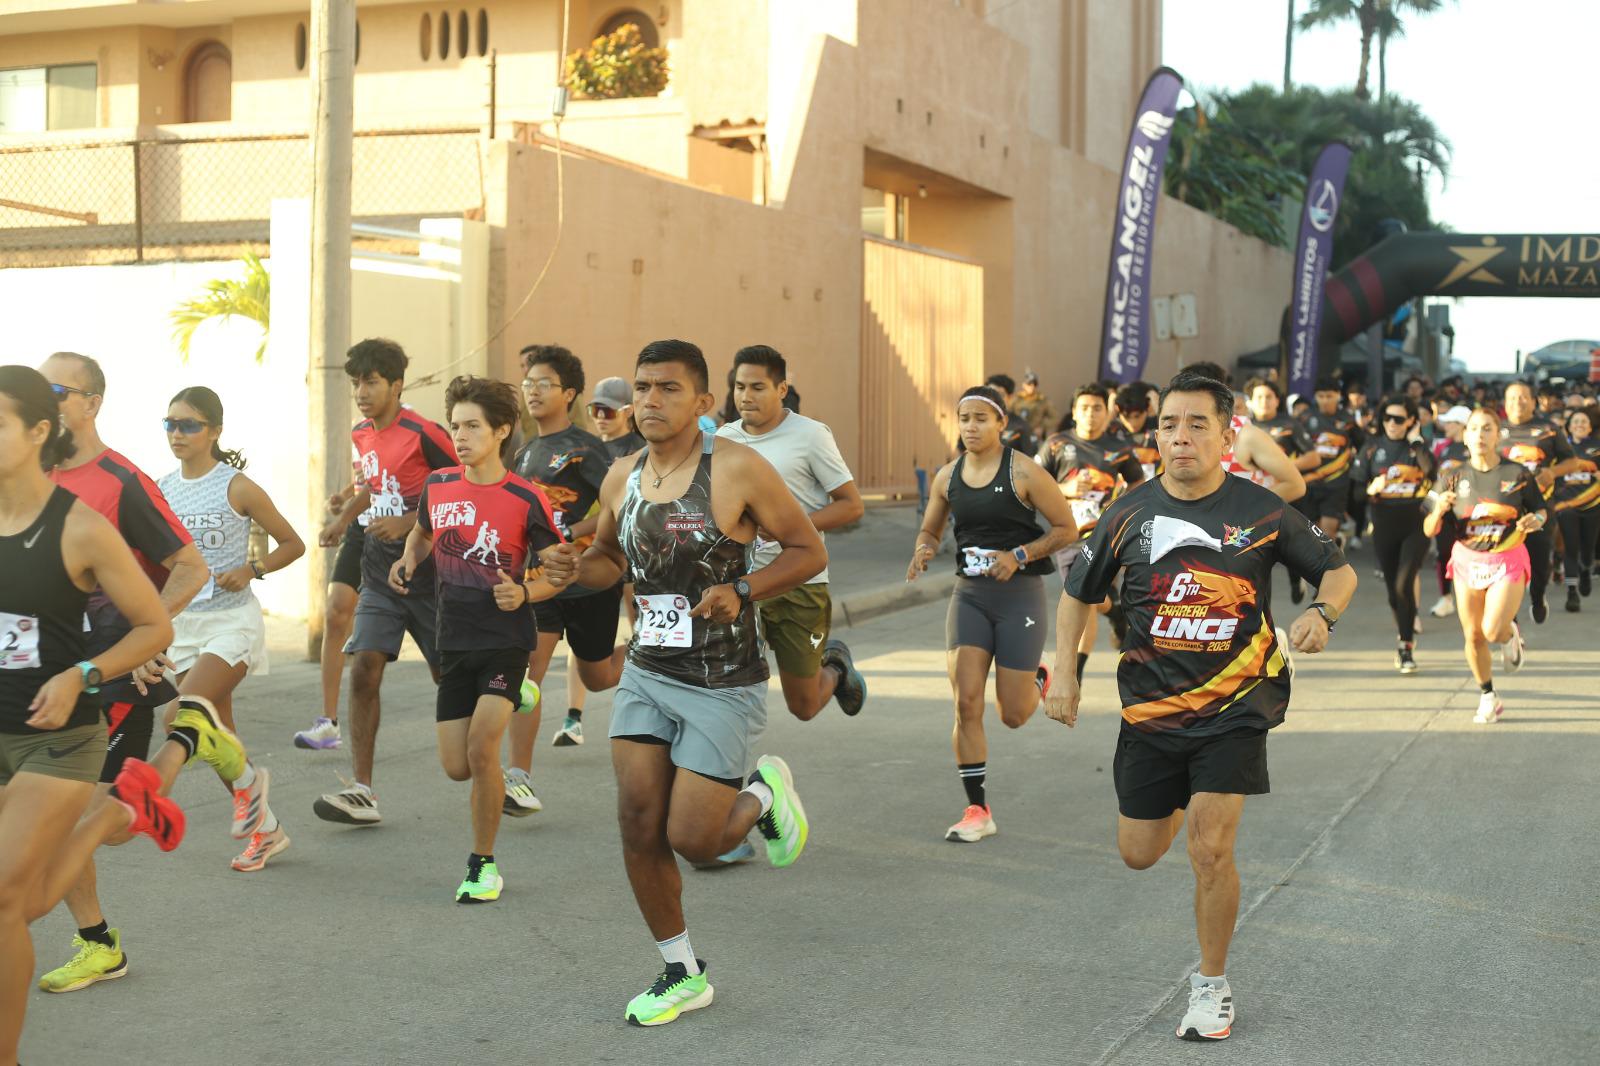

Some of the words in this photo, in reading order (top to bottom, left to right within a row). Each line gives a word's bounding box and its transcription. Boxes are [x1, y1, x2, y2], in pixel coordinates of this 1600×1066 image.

[1131, 163, 1158, 277] RESIDENCIAL
[1108, 145, 1154, 375] ARCANGEL
[1521, 236, 1600, 263] IMD
[1126, 284, 1142, 367] DISTRITO
[431, 501, 474, 516] LUPE'S
[431, 511, 475, 530] TEAM
[647, 609, 680, 630] 229
[1157, 603, 1210, 618] CARRERA
[1150, 615, 1239, 641] LINCE
